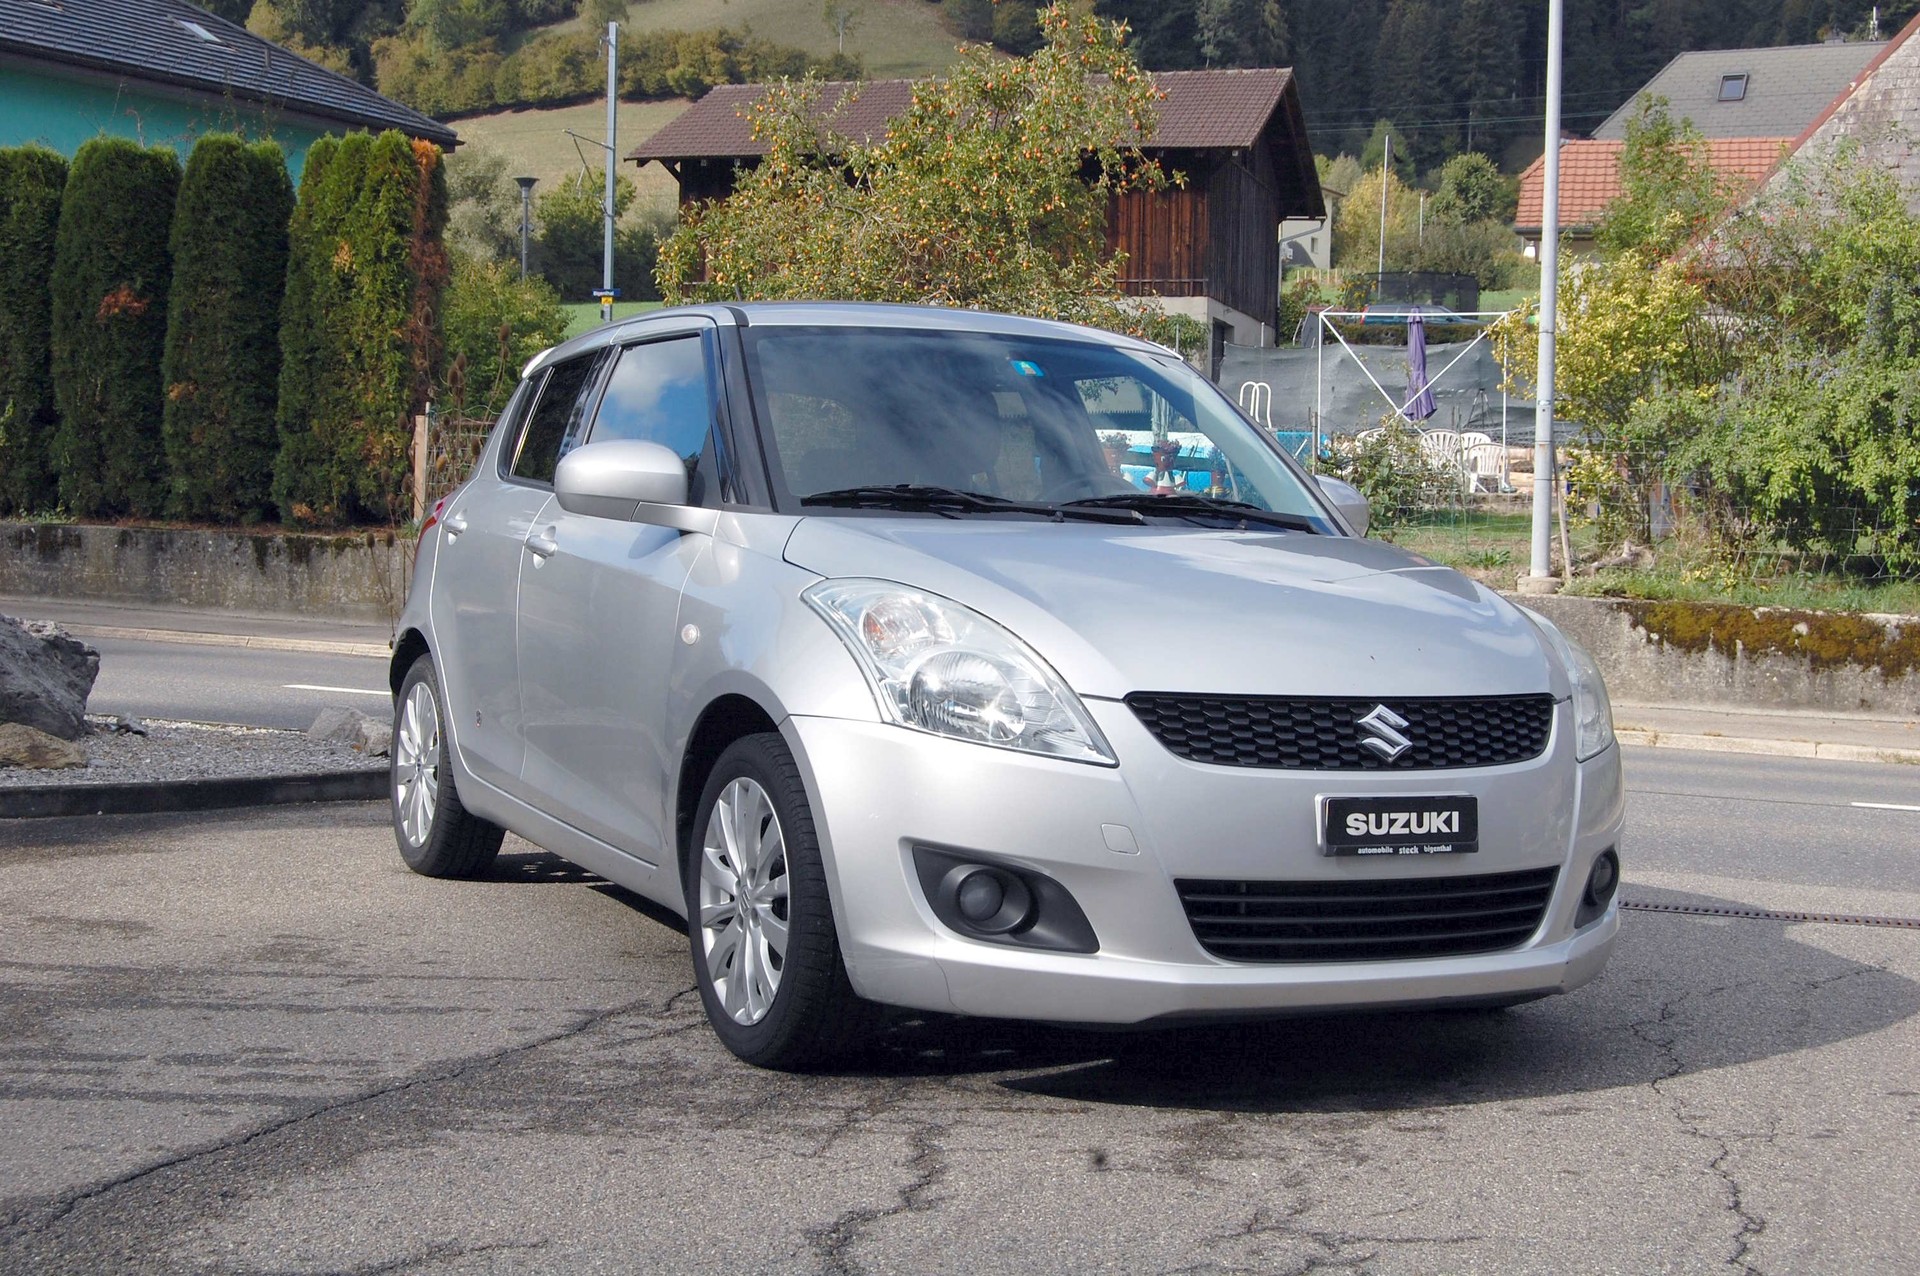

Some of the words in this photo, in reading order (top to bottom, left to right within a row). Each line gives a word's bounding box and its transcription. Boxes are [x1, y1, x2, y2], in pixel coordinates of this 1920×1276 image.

[1346, 811, 1459, 836] SUZUKI
[1358, 846, 1393, 854] automobile
[1399, 846, 1419, 854] steck
